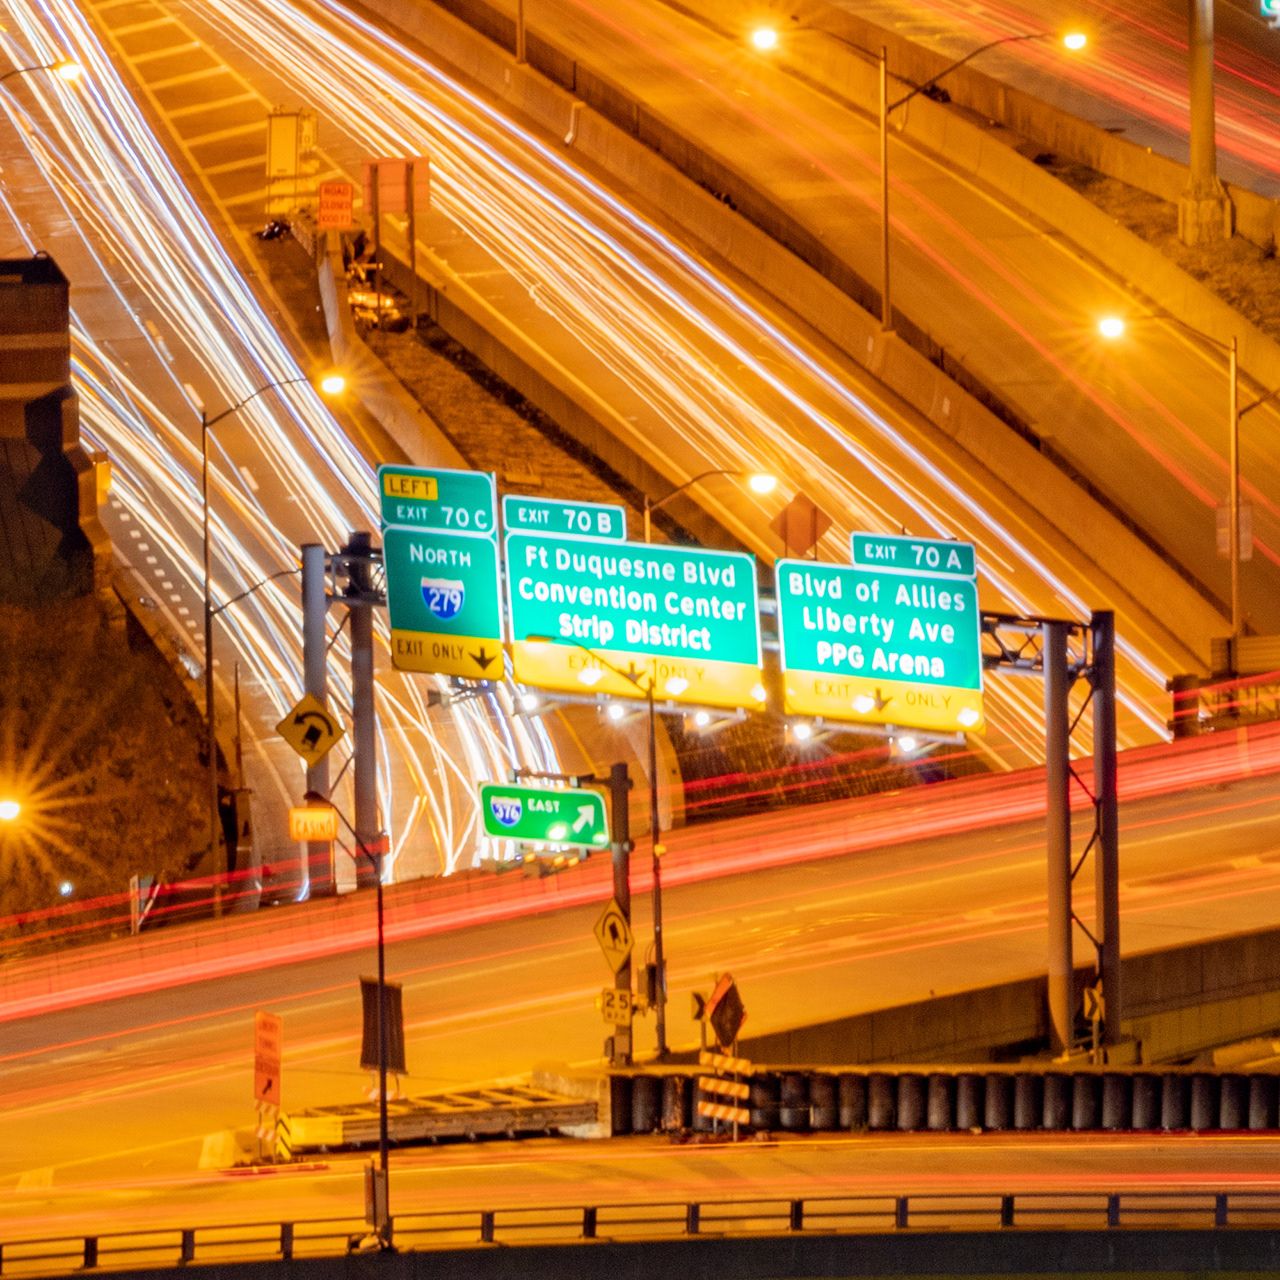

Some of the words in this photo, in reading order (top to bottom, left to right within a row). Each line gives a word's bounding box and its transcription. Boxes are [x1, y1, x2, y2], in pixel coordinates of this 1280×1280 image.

[324, 187, 348, 196] ROAD
[321, 201, 352, 210] CLOSED
[388, 476, 432, 497] LEFT
[398, 506, 426, 518] EXIT
[519, 508, 549, 523] EXIT
[410, 545, 471, 566] NORTH
[865, 544, 896, 559] EXIT
[526, 546, 548, 568] Ft
[556, 548, 678, 581] Duquesne
[684, 562, 735, 587] Blvd
[428, 589, 462, 614] 279
[519, 576, 658, 612] Convention
[665, 592, 746, 620] Center
[789, 573, 841, 599] Blvd
[856, 580, 879, 602] of
[896, 584, 964, 611] Allies
[558, 613, 614, 646] Strip
[626, 619, 711, 651] District
[803, 606, 894, 644] Liberty
[909, 618, 954, 643] Ave
[397, 640, 422, 657] EXIT
[432, 643, 464, 660] ONLY
[817, 641, 864, 669] PPG
[871, 648, 944, 679] Arena
[659, 663, 705, 682] ONLY
[814, 681, 849, 698] EXIT
[906, 692, 951, 709] ONLY
[496, 805, 519, 820] 376
[528, 798, 559, 812] EAST
[295, 818, 333, 837] CASINO
[606, 992, 628, 1009] 25
